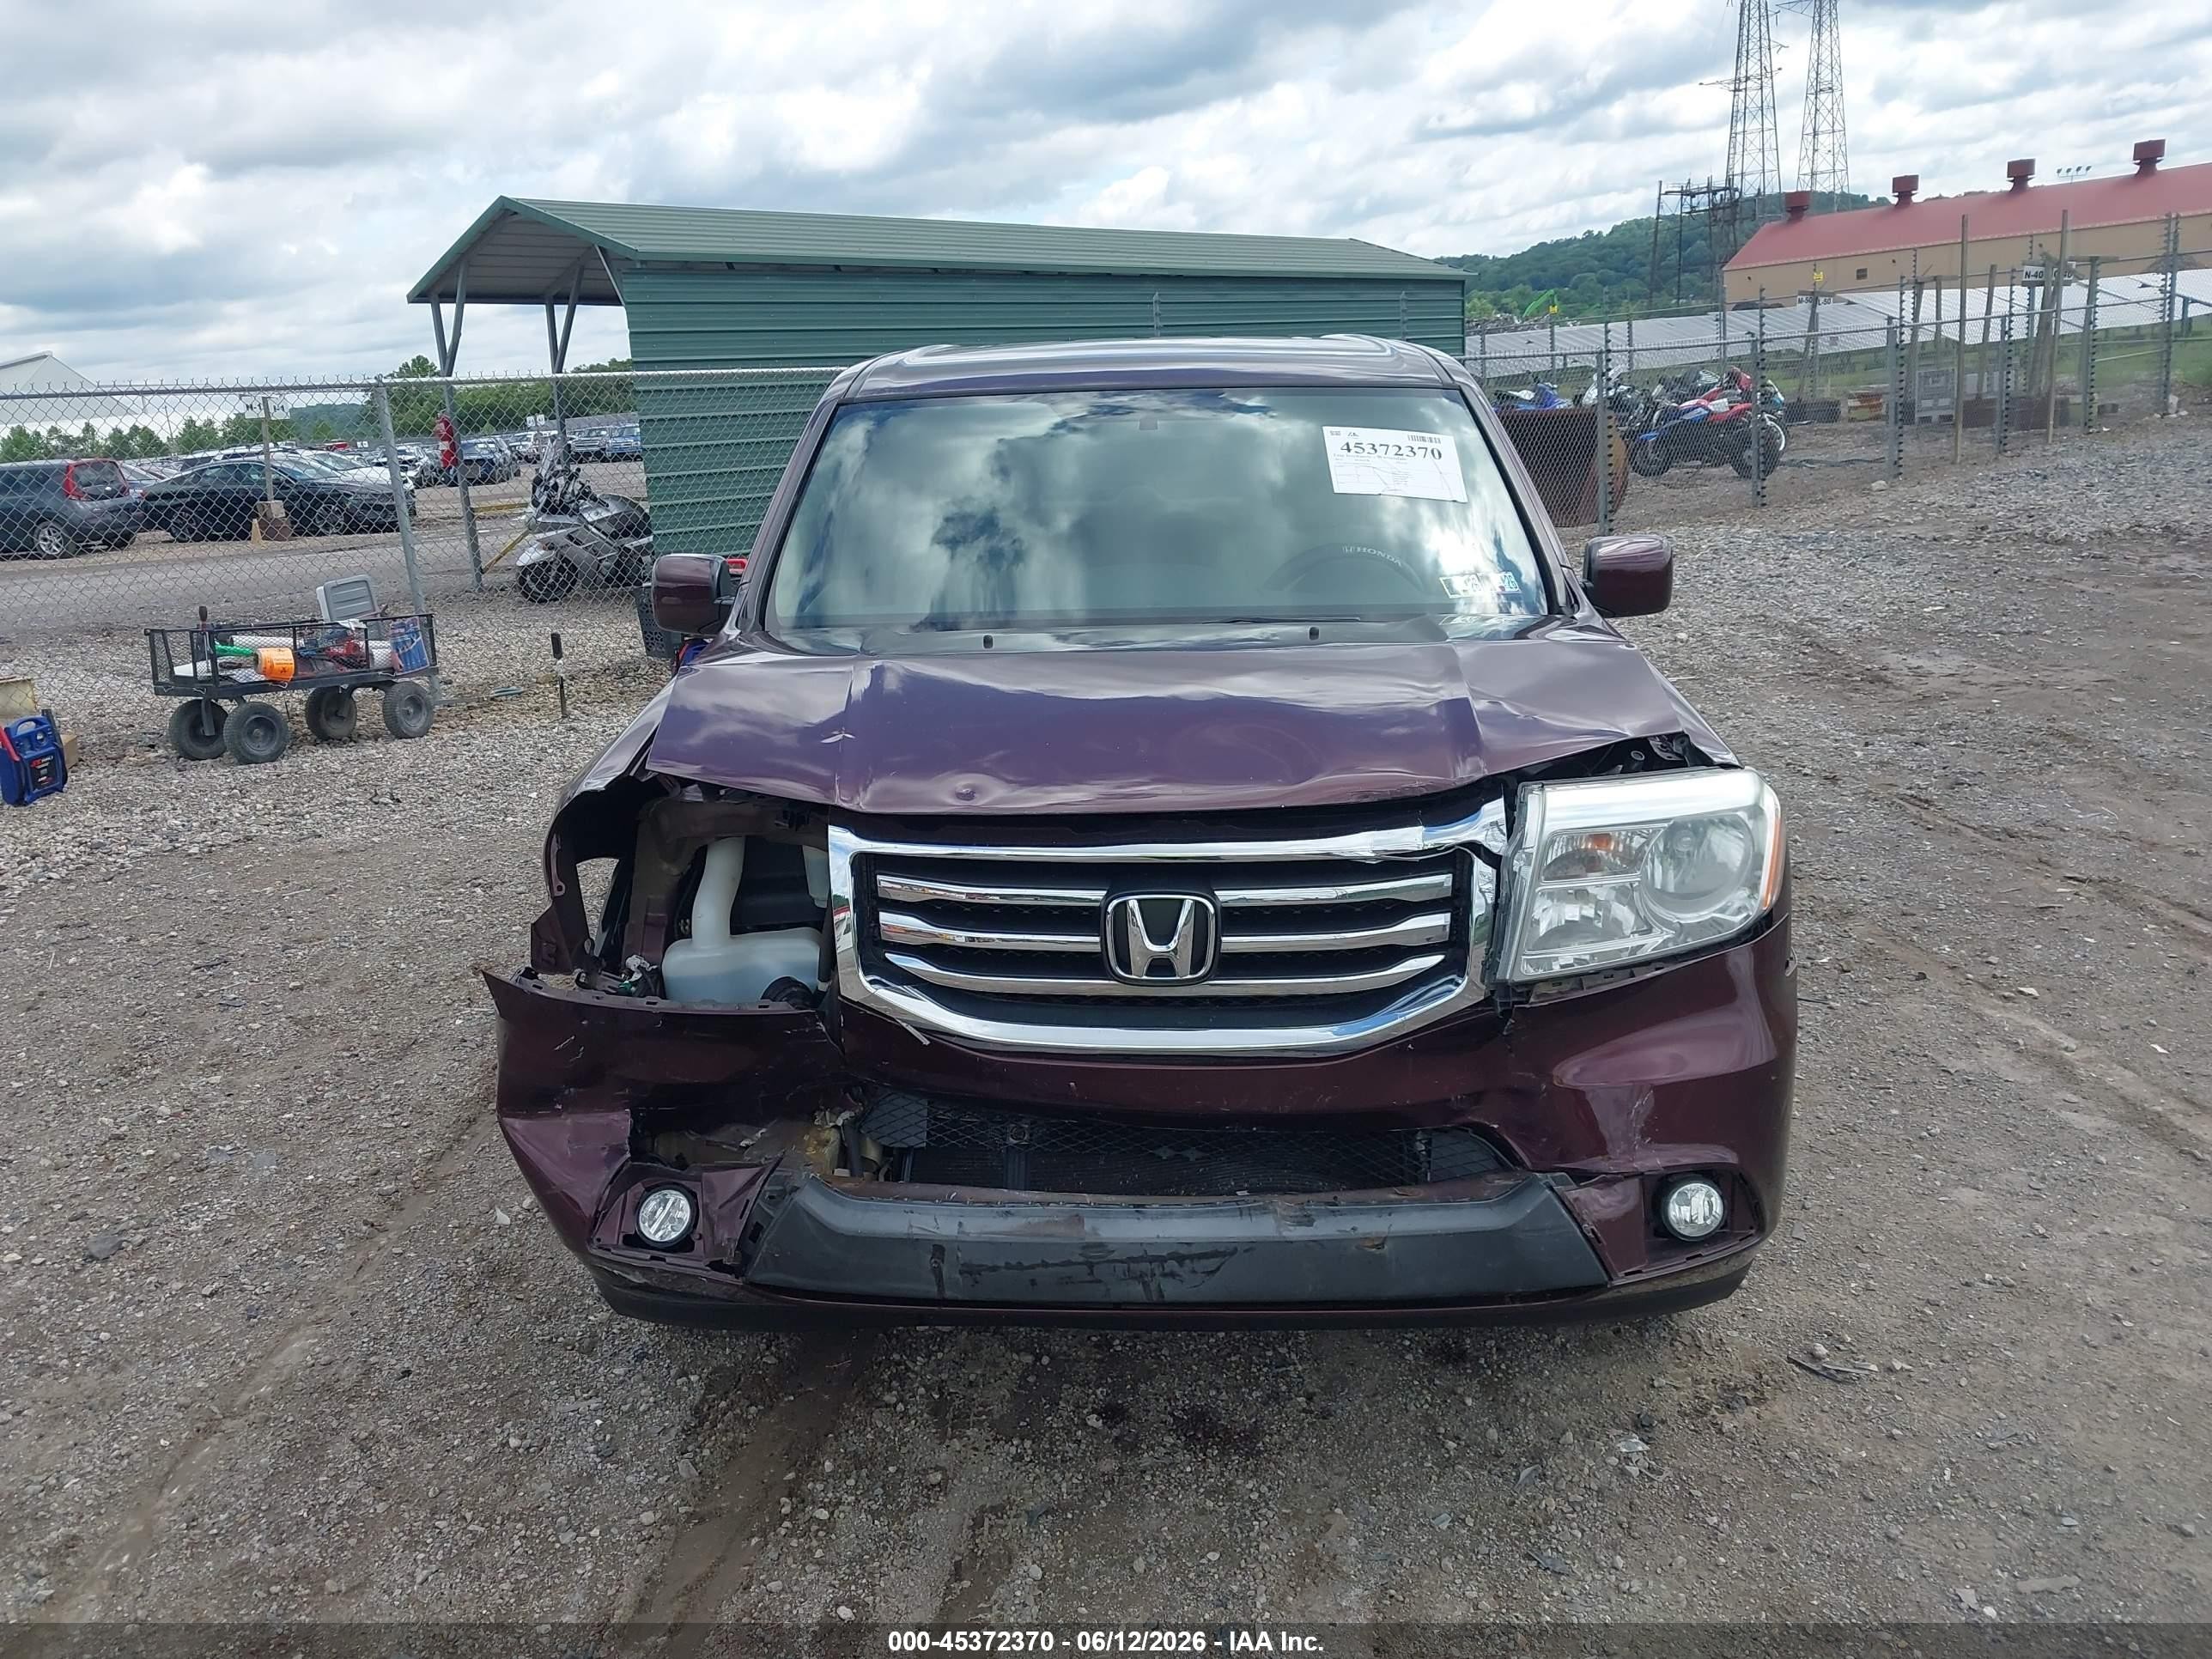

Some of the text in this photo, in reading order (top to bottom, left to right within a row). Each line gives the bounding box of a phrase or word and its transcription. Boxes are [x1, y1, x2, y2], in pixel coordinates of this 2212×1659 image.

[2024, 270, 2044, 279] N-40
[1340, 441, 1443, 460] 45372370
[1357, 546, 1402, 567] HONDA
